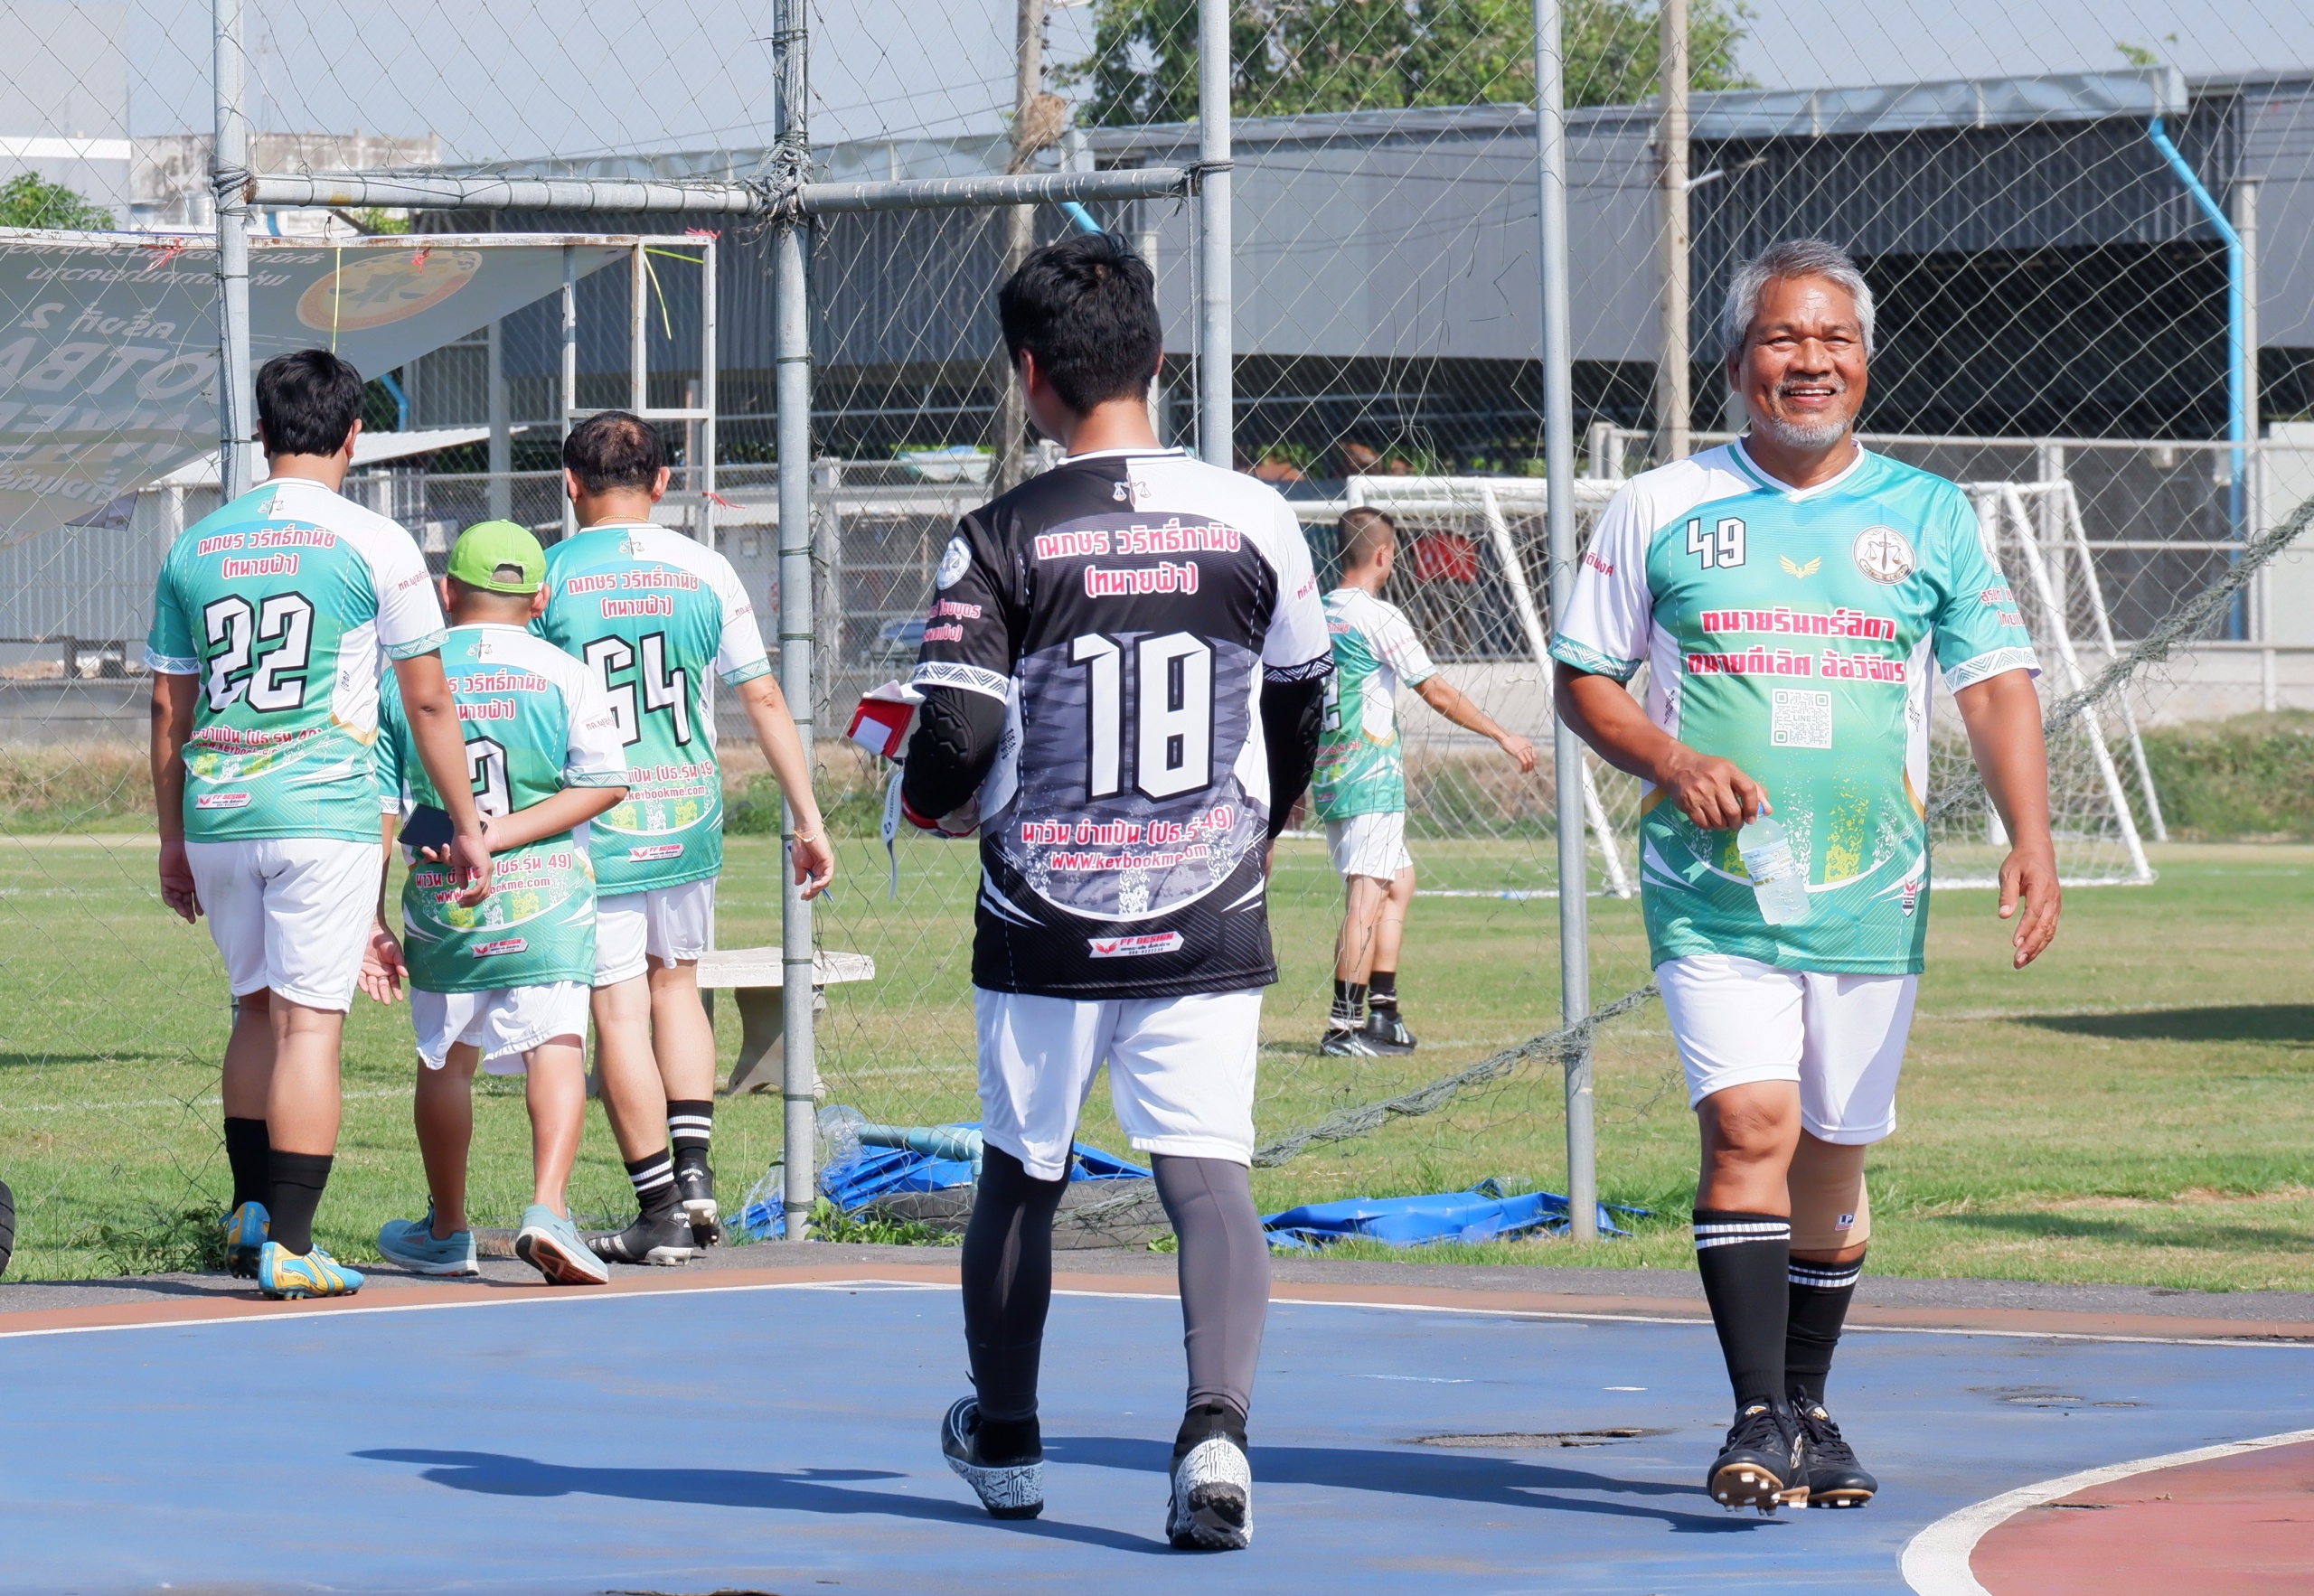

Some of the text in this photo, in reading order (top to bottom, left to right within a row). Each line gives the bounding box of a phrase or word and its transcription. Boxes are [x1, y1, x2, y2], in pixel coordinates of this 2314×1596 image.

[1687, 516, 1746, 570] 49
[221, 552, 300, 580] (ทนายฟ้า)
[1085, 561, 1199, 597] (ทนายฟ้า)
[600, 596, 673, 619] (ทนายฟ้า)
[202, 590, 315, 715] 22
[582, 631, 691, 747] 64
[1068, 632, 1217, 803] 18
[1793, 714, 1811, 722] LINE
[1022, 820, 1070, 844] นาวิน
[548, 853, 572, 869] 49)
[1120, 933, 1173, 945] FF DESIGN
[1839, 1214, 1854, 1225] LP
